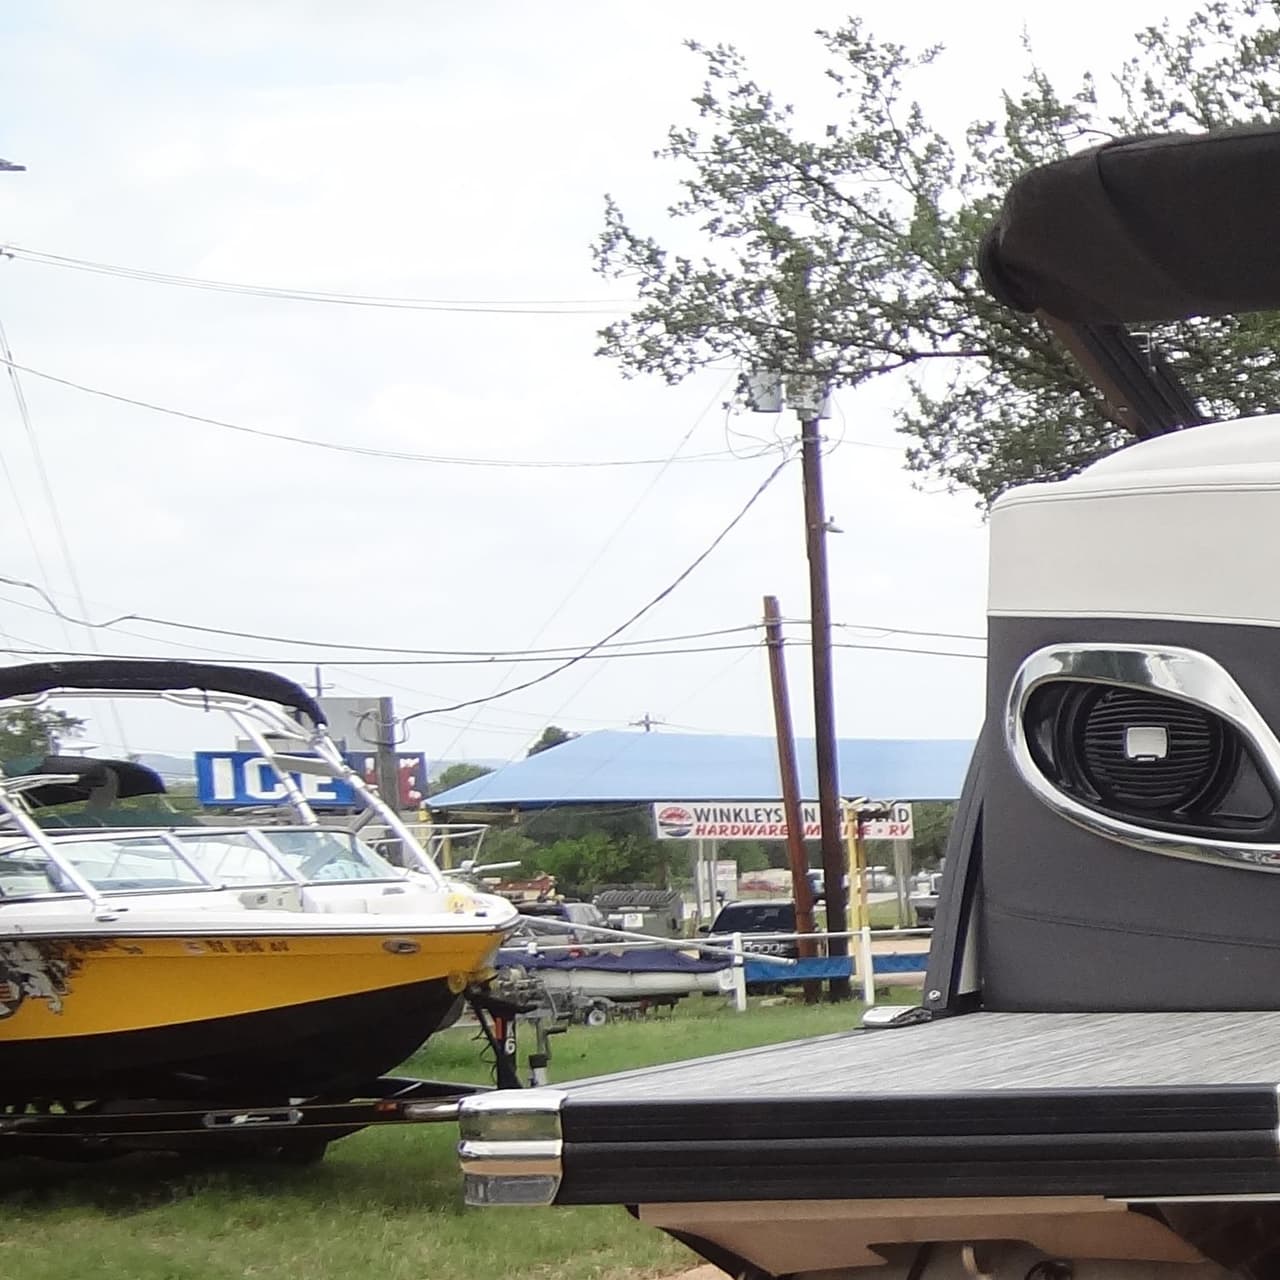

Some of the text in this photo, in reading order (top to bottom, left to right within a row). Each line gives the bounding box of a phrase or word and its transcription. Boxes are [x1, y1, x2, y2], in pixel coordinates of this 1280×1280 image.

[694, 807, 784, 823] WINKLEYS
[695, 823, 791, 836] HARDWARE
[888, 824, 911, 836] RV
